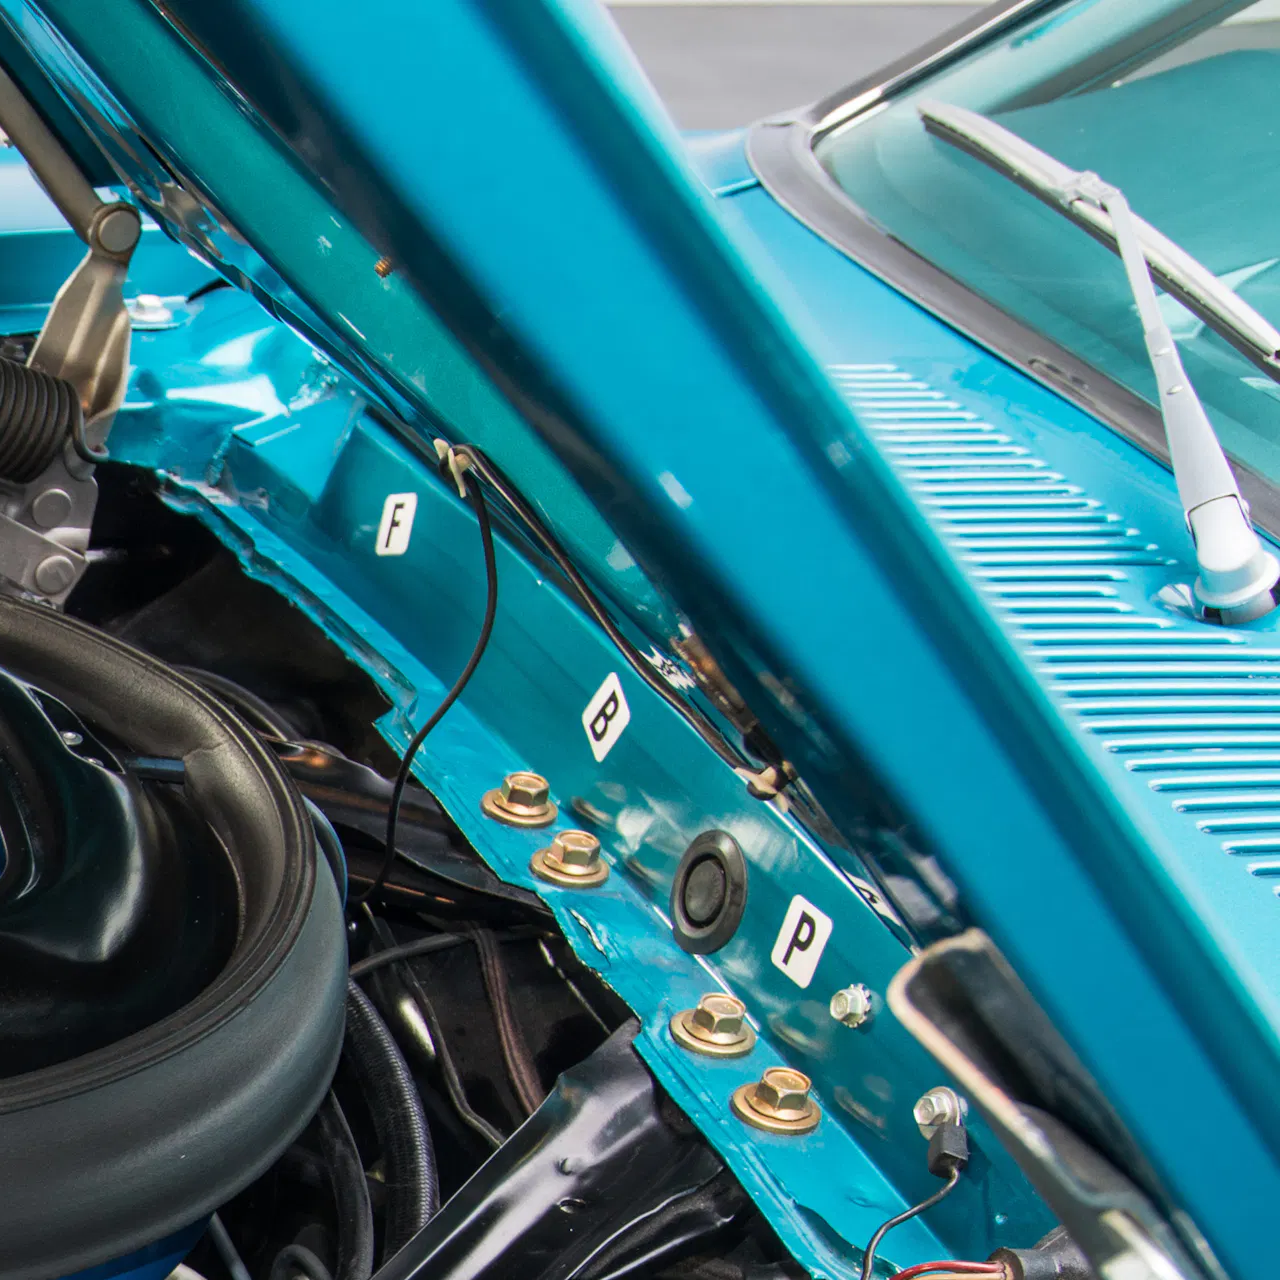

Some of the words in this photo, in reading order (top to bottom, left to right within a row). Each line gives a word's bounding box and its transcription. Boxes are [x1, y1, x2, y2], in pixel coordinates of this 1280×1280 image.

[385, 502, 408, 545] F
[590, 690, 618, 738] B
[782, 912, 815, 965] P
